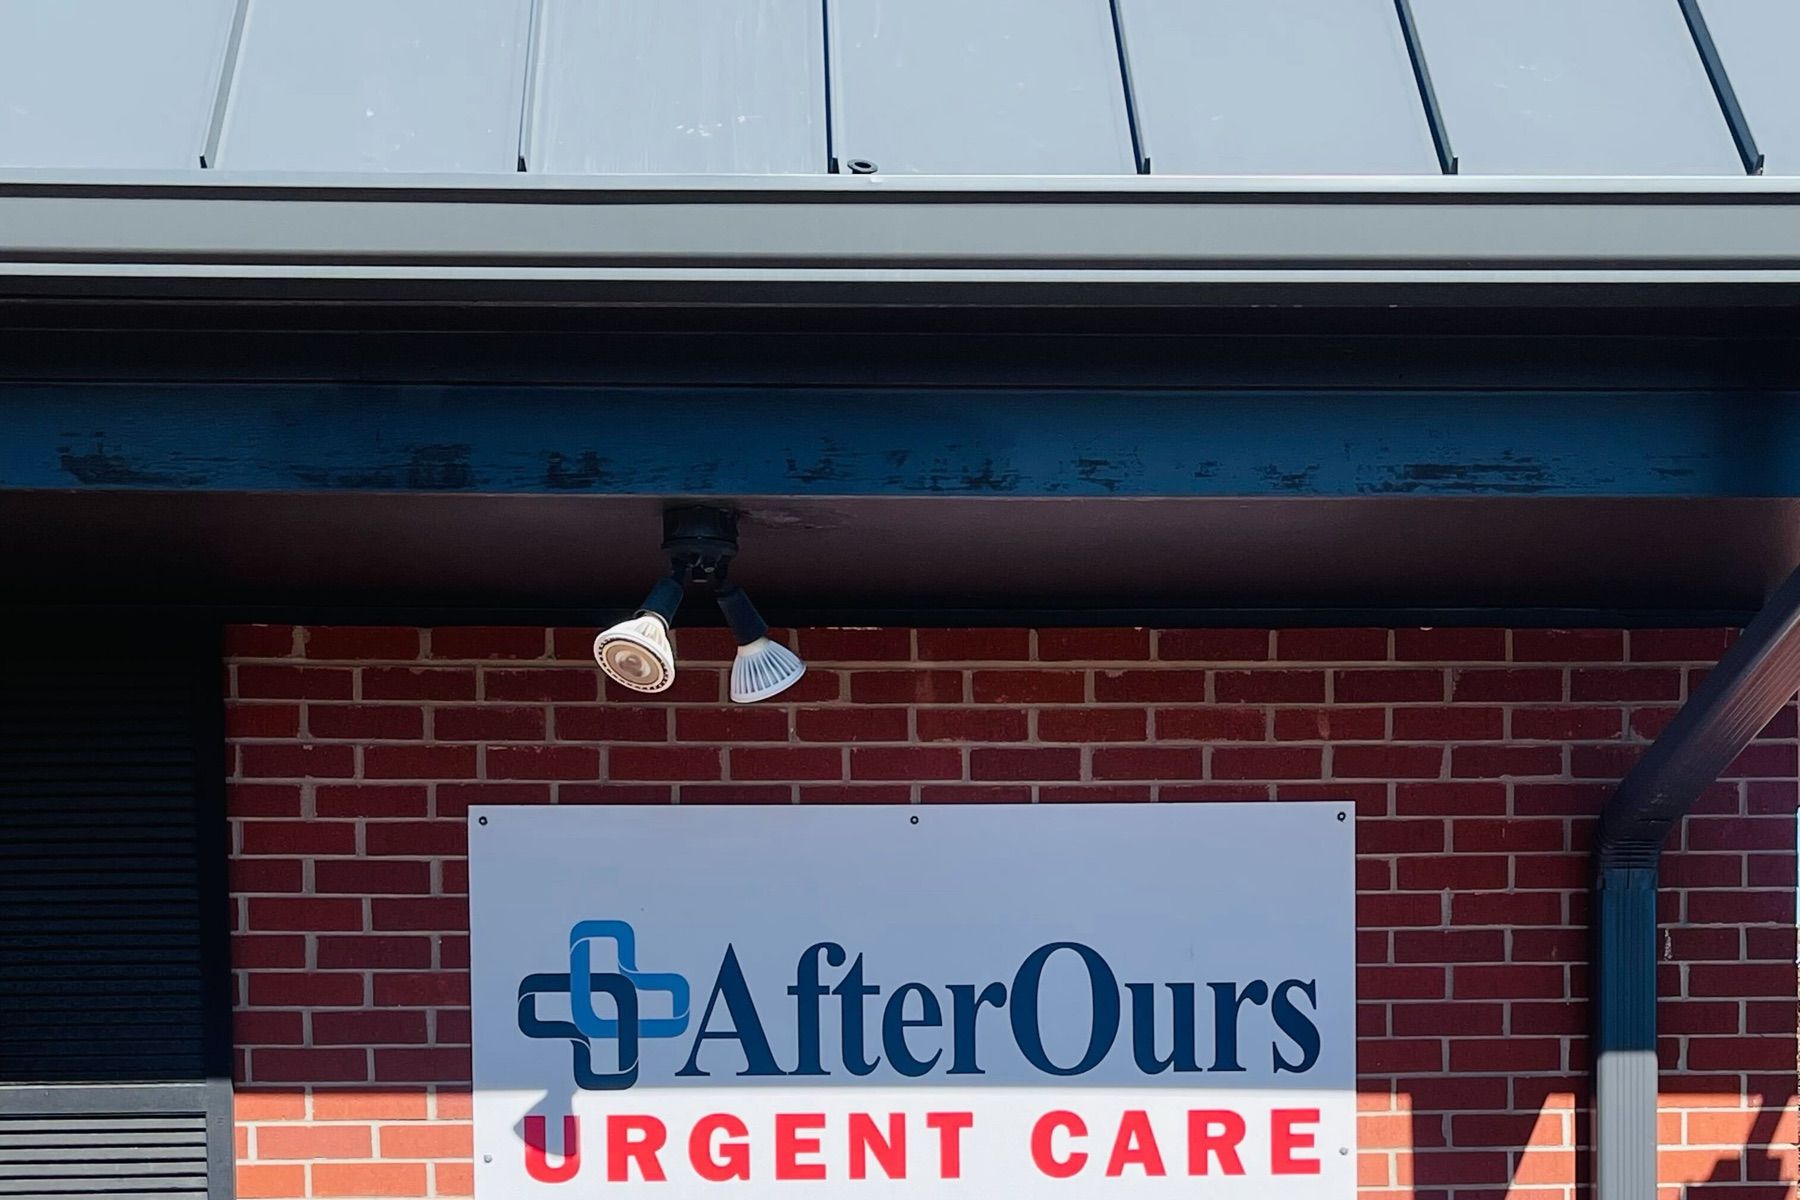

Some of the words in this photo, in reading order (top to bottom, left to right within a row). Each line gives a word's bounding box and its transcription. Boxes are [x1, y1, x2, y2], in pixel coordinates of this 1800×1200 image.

[675, 941, 1321, 1078] AfterOurs
[524, 1111, 974, 1183] URGENT
[1030, 1108, 1321, 1177] CARE
